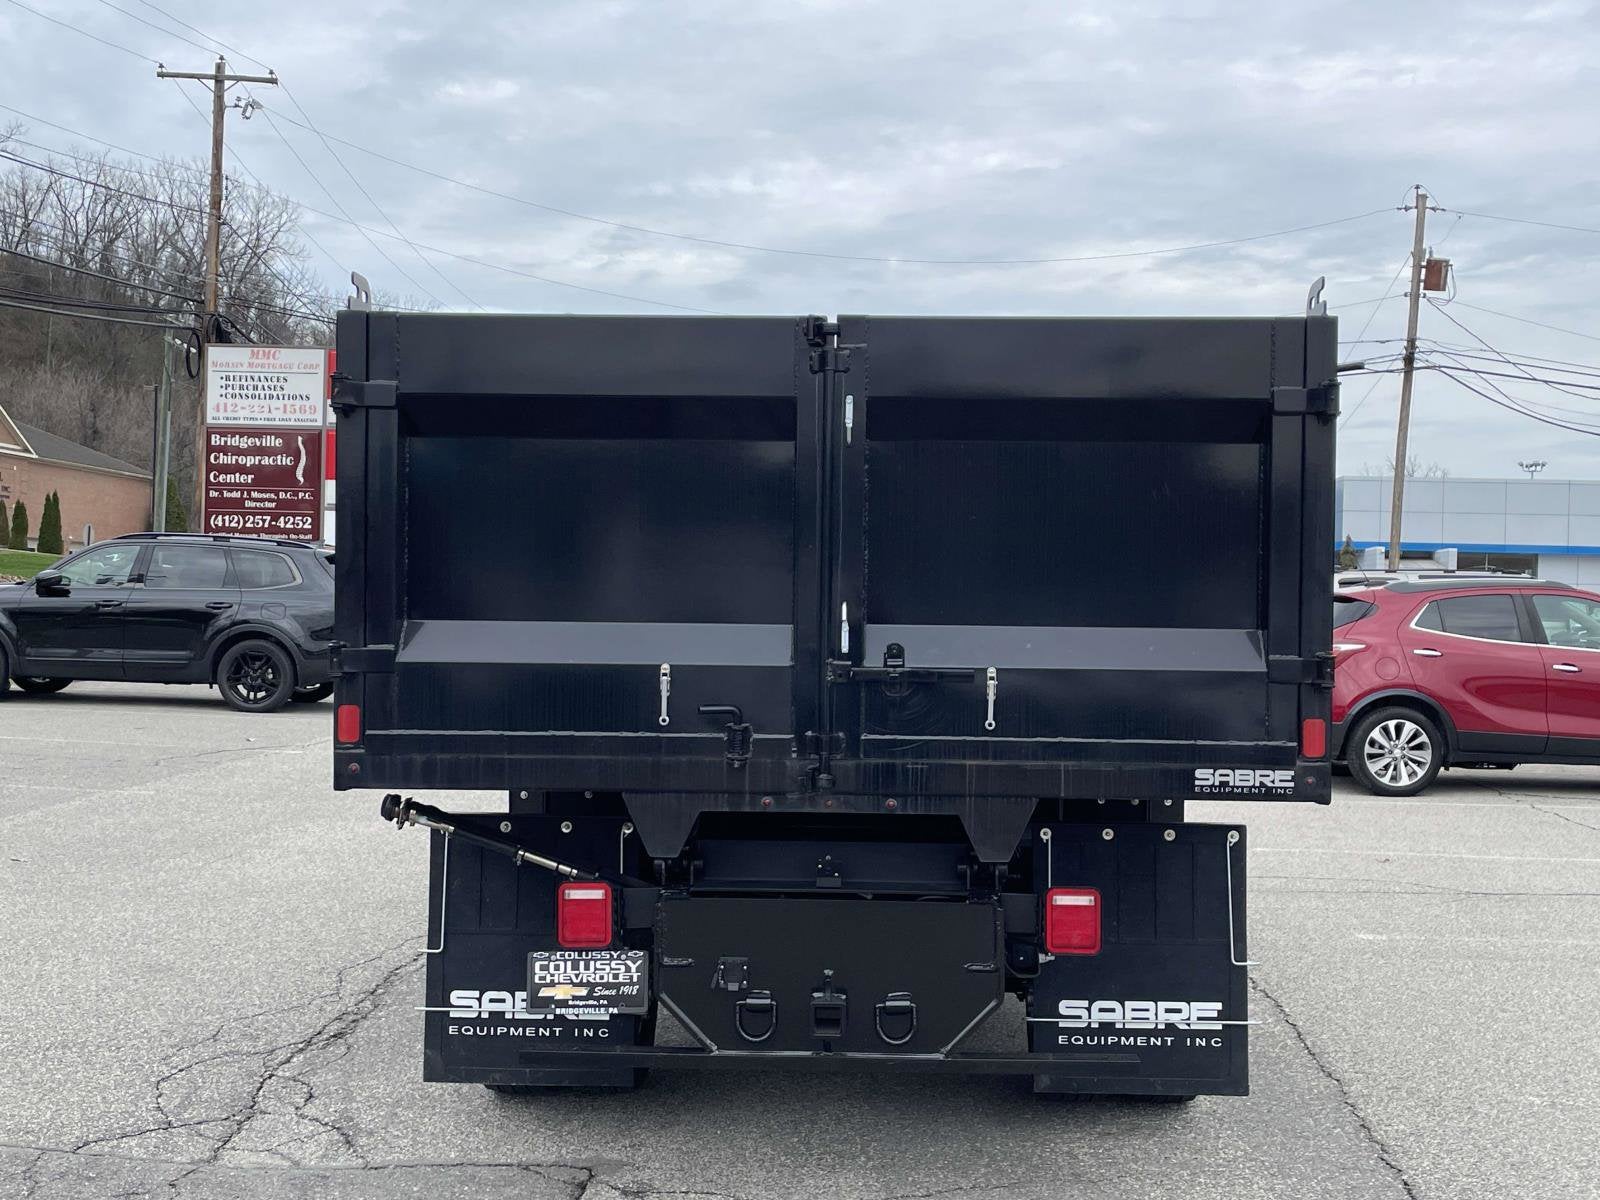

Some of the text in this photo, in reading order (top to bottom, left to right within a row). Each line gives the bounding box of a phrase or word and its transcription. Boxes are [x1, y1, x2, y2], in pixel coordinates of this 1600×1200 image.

[249, 349, 281, 360] MMC
[225, 374, 288, 383] REFINANCES
[225, 383, 285, 392] PURCHASES
[225, 392, 310, 401] CONSOLIDATIONS
[212, 402, 317, 415] 412-221-1569
[210, 434, 283, 448] Bridgeville
[209, 452, 295, 467] Chiropractic
[209, 471, 255, 483] Center
[209, 490, 221, 498] Dr.
[223, 490, 241, 498] Todd
[251, 491, 277, 499] Moses,
[245, 500, 277, 508] Director
[210, 514, 312, 529] (412) 257-4252
[1194, 768, 1295, 787] SABRE
[1194, 786, 1266, 794] EQUIPMENT
[556, 951, 621, 960] COLUSSY
[534, 960, 643, 974] COLUSSY
[534, 972, 641, 983] CHEVROLET
[593, 985, 640, 996] Since 1918
[1058, 999, 1223, 1030] SABRE
[449, 1026, 609, 1038] EQUIPMENT INC
[1058, 1035, 1223, 1047] EQUIPMENT INC
